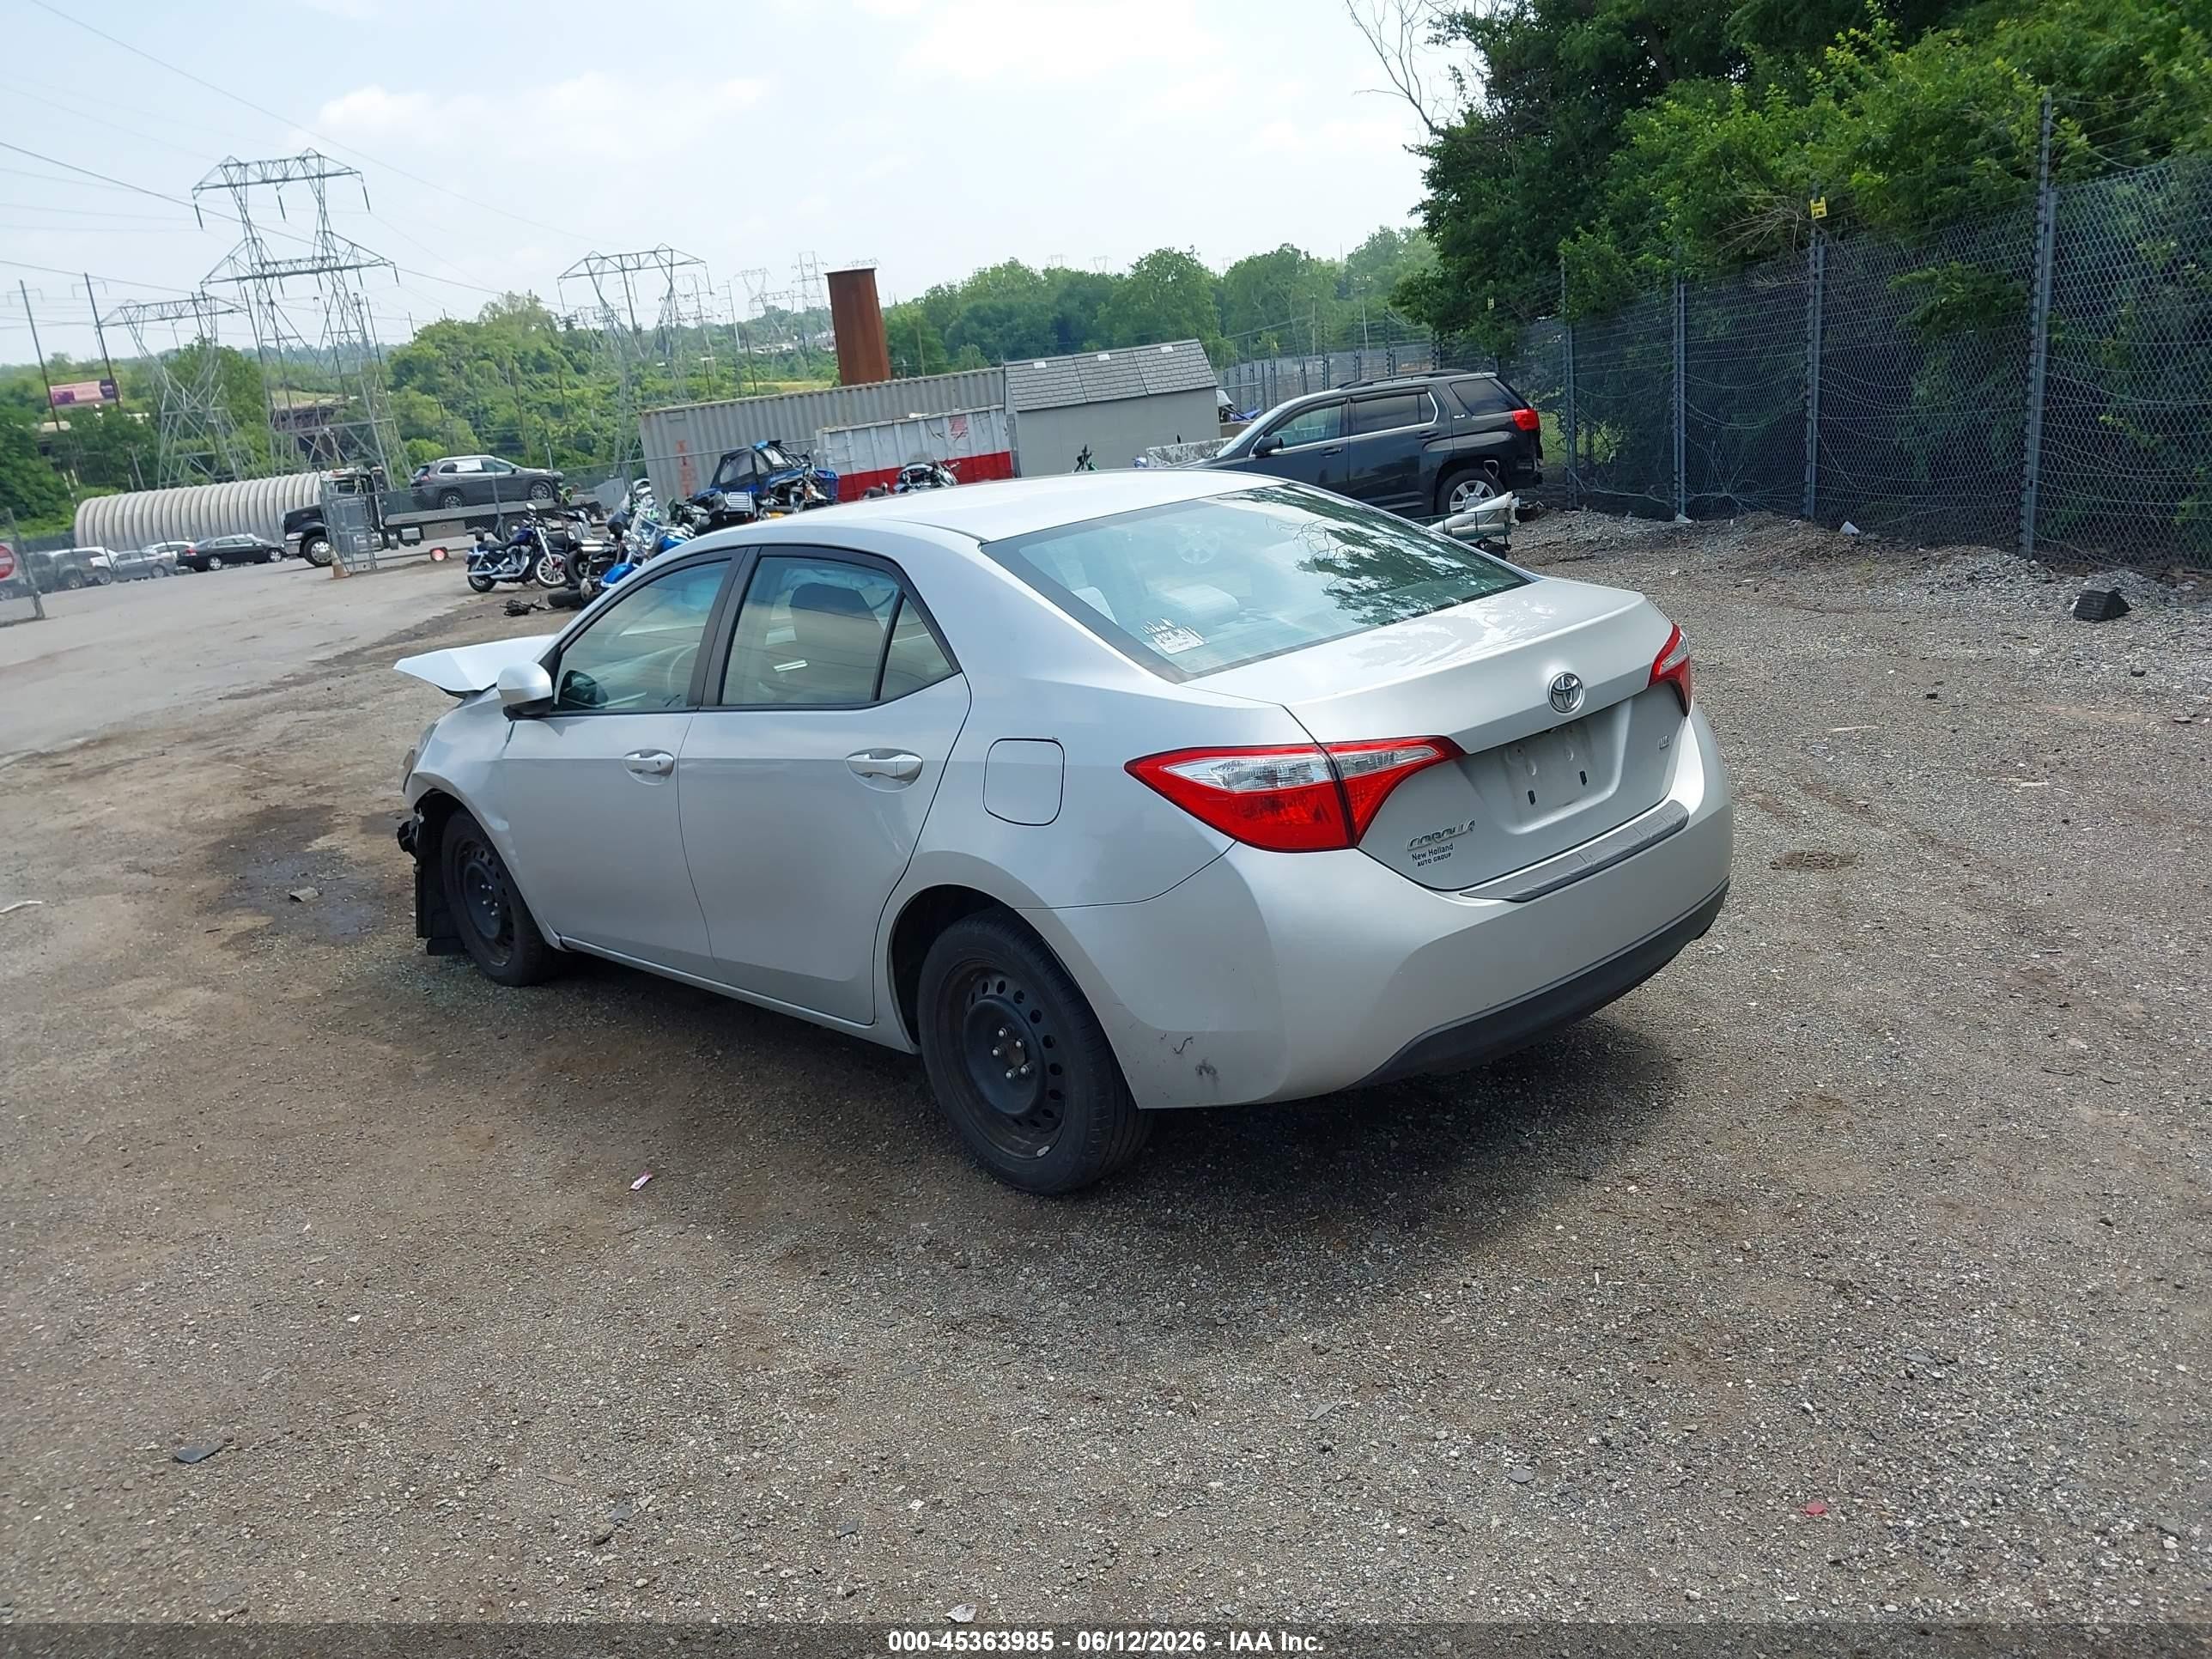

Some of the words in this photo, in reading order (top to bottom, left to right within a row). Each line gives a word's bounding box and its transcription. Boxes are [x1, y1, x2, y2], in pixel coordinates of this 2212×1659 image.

[1407, 819, 1475, 851] COROLLA
[1412, 852, 1426, 861] New
[1428, 842, 1454, 856] Holland
[1433, 853, 1451, 862] GROUP
